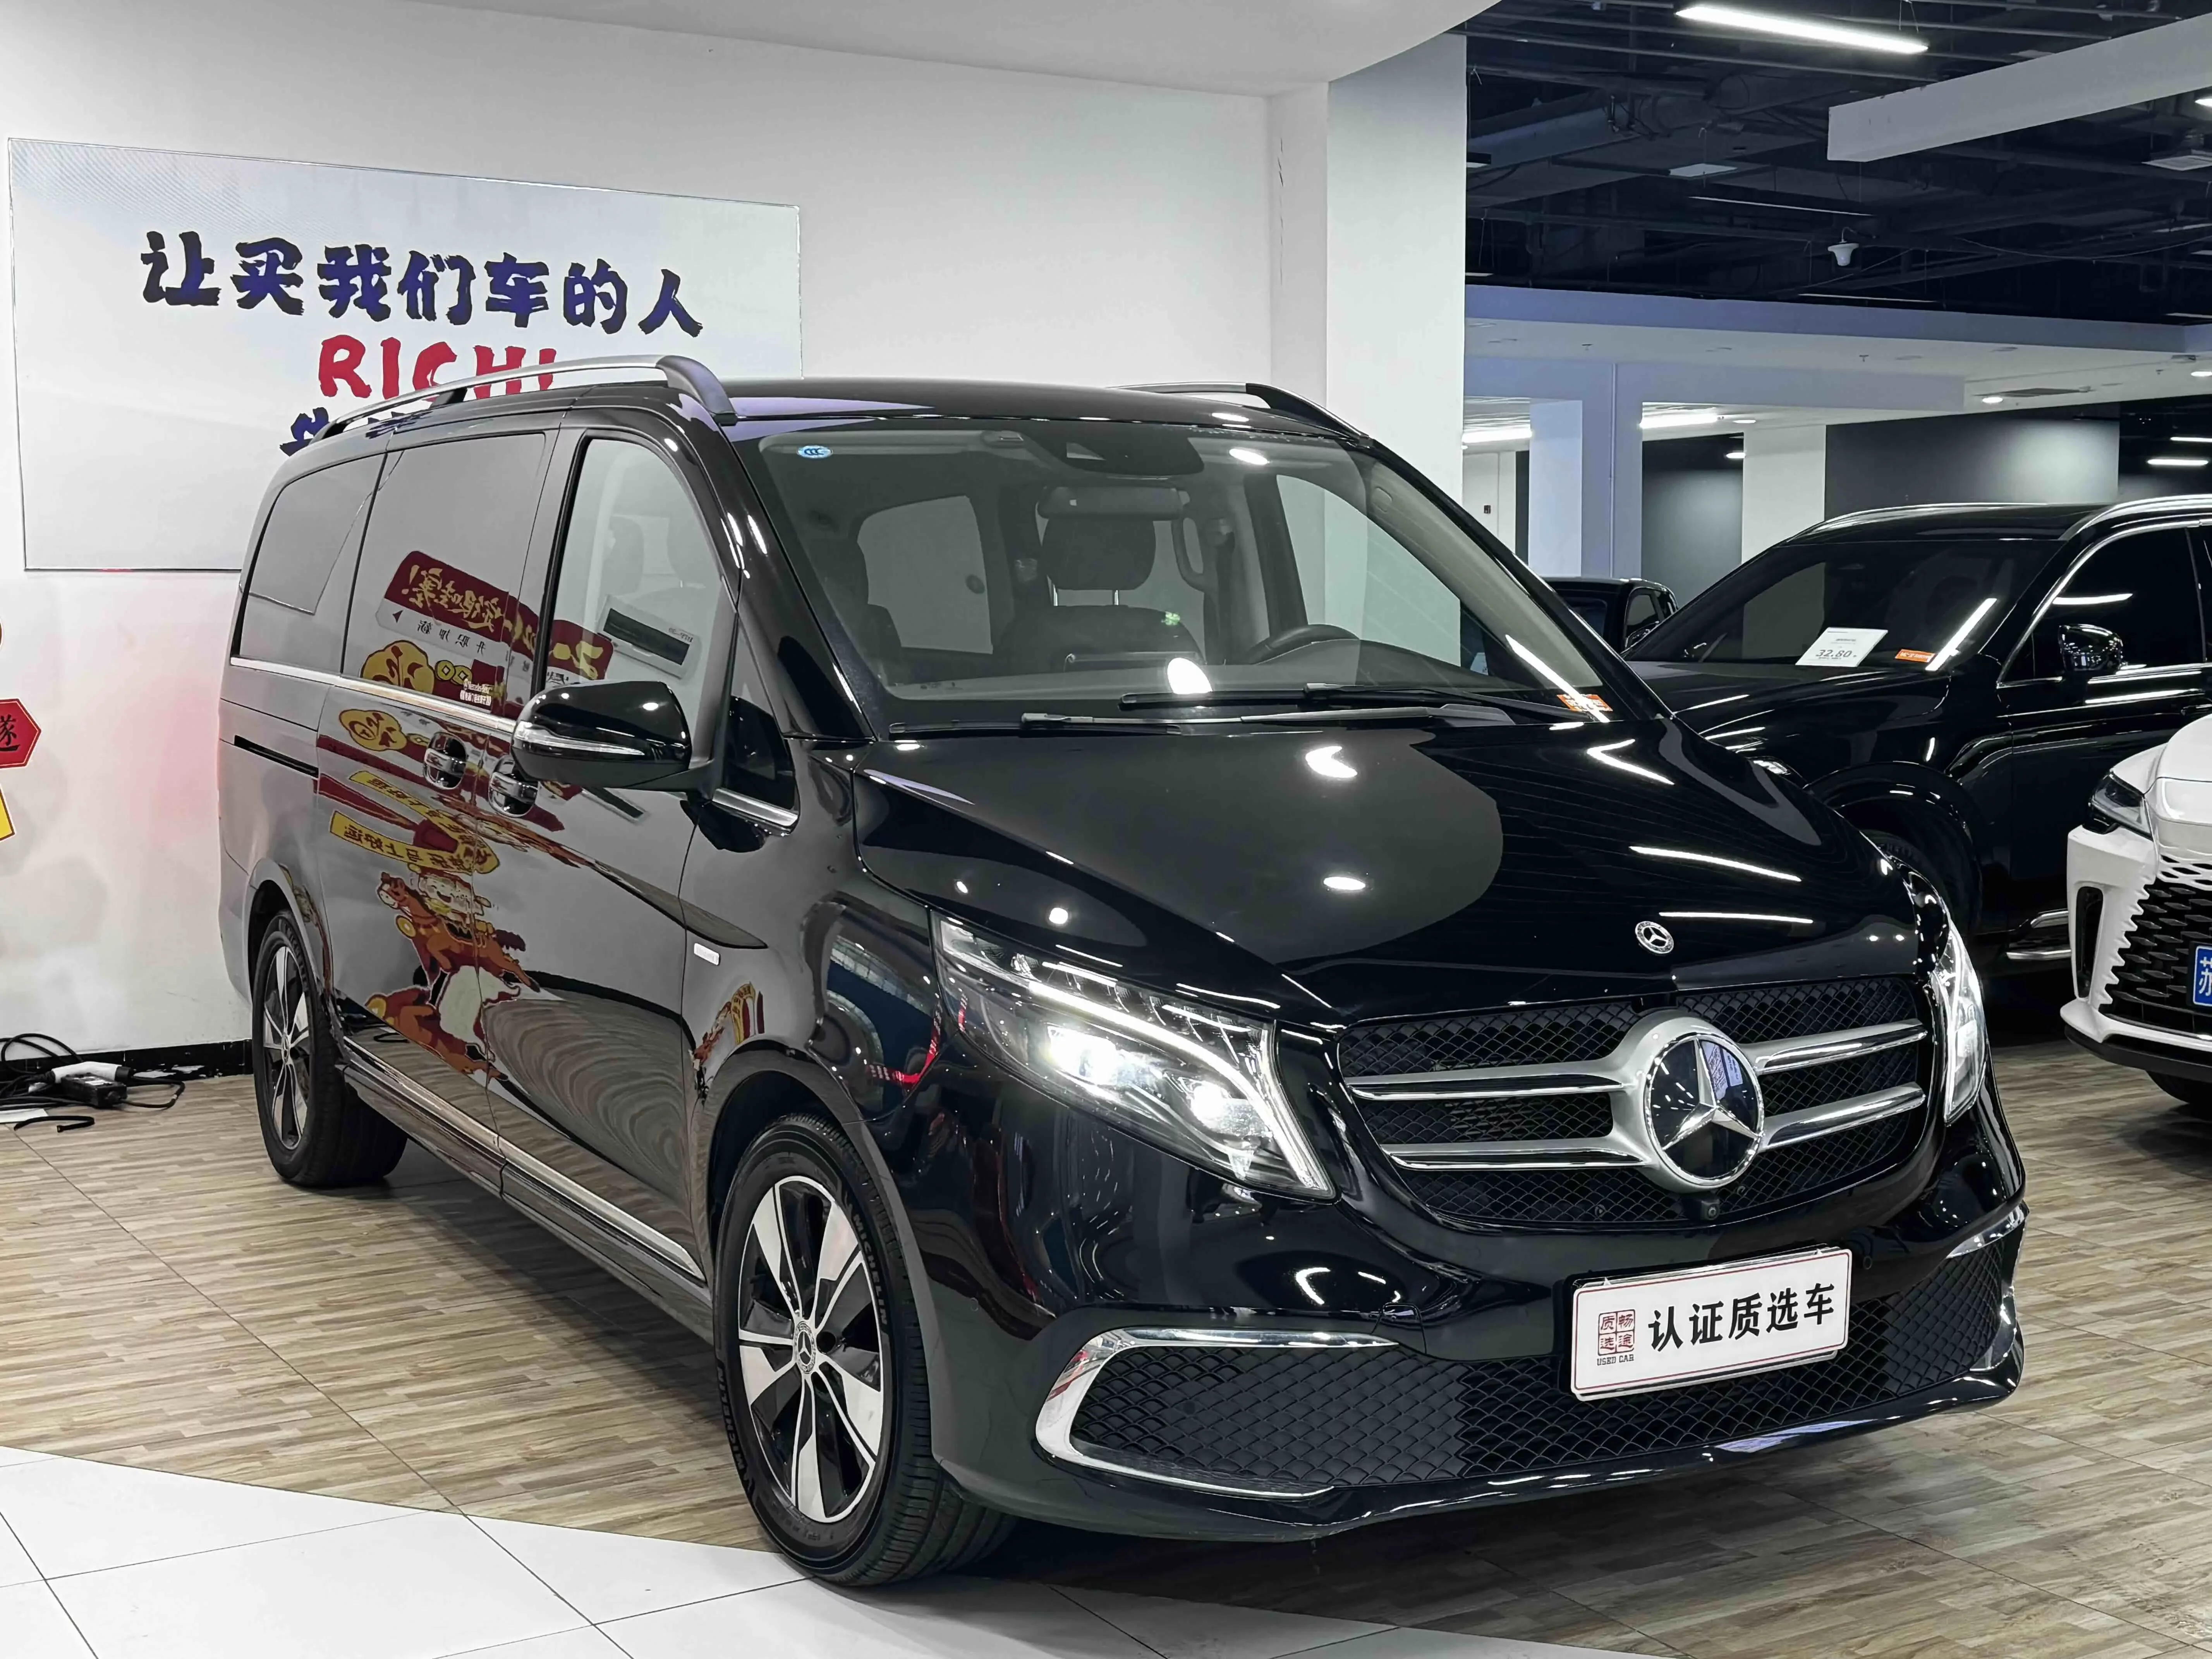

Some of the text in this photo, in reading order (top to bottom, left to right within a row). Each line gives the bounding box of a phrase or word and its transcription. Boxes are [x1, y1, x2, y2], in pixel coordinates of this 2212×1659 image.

[141, 231, 703, 337] 让买我们车的人
[852, 1213, 888, 1326] MICHELIN
[1648, 1283, 1835, 1352] 认证质选车
